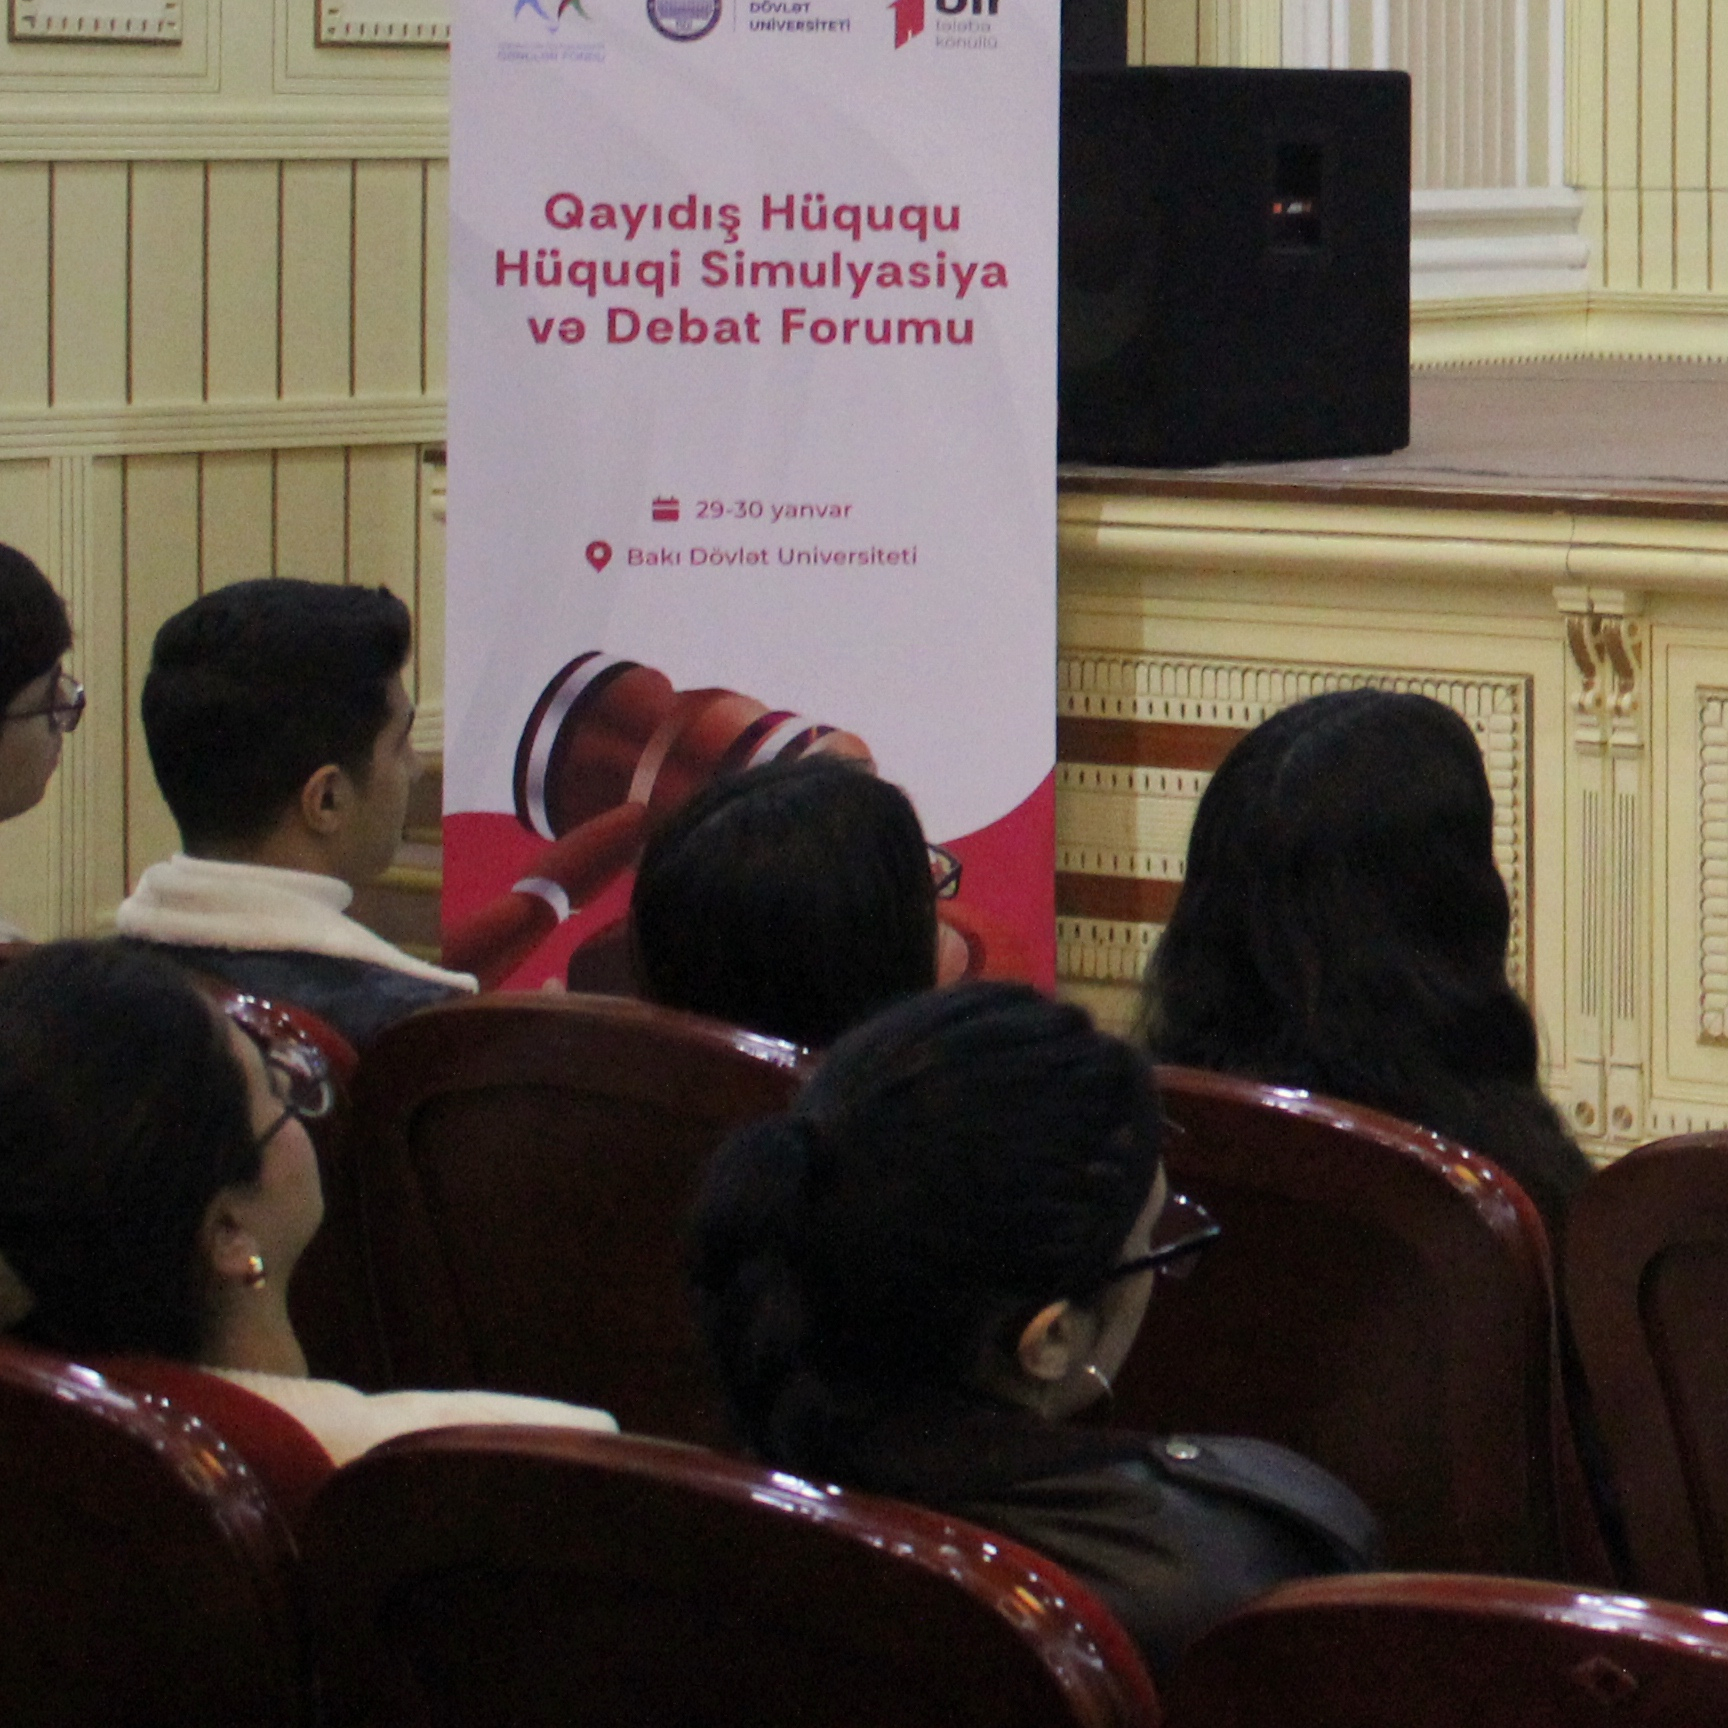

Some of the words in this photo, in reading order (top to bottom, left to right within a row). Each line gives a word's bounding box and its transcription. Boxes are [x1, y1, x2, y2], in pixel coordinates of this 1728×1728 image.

[544, 191, 741, 243] Qayıdış
[761, 193, 961, 241] Hüququ
[495, 249, 681, 298] Hüquqi
[701, 250, 1009, 299] Simulyasiya
[527, 316, 587, 345] və
[606, 307, 761, 345] Debat
[781, 307, 975, 345] Forumu
[695, 500, 764, 520] 29-30
[770, 503, 852, 524] yanvar
[627, 546, 681, 567] Bakı
[689, 547, 769, 567] Dövlət
[777, 545, 918, 567] Universiteti
